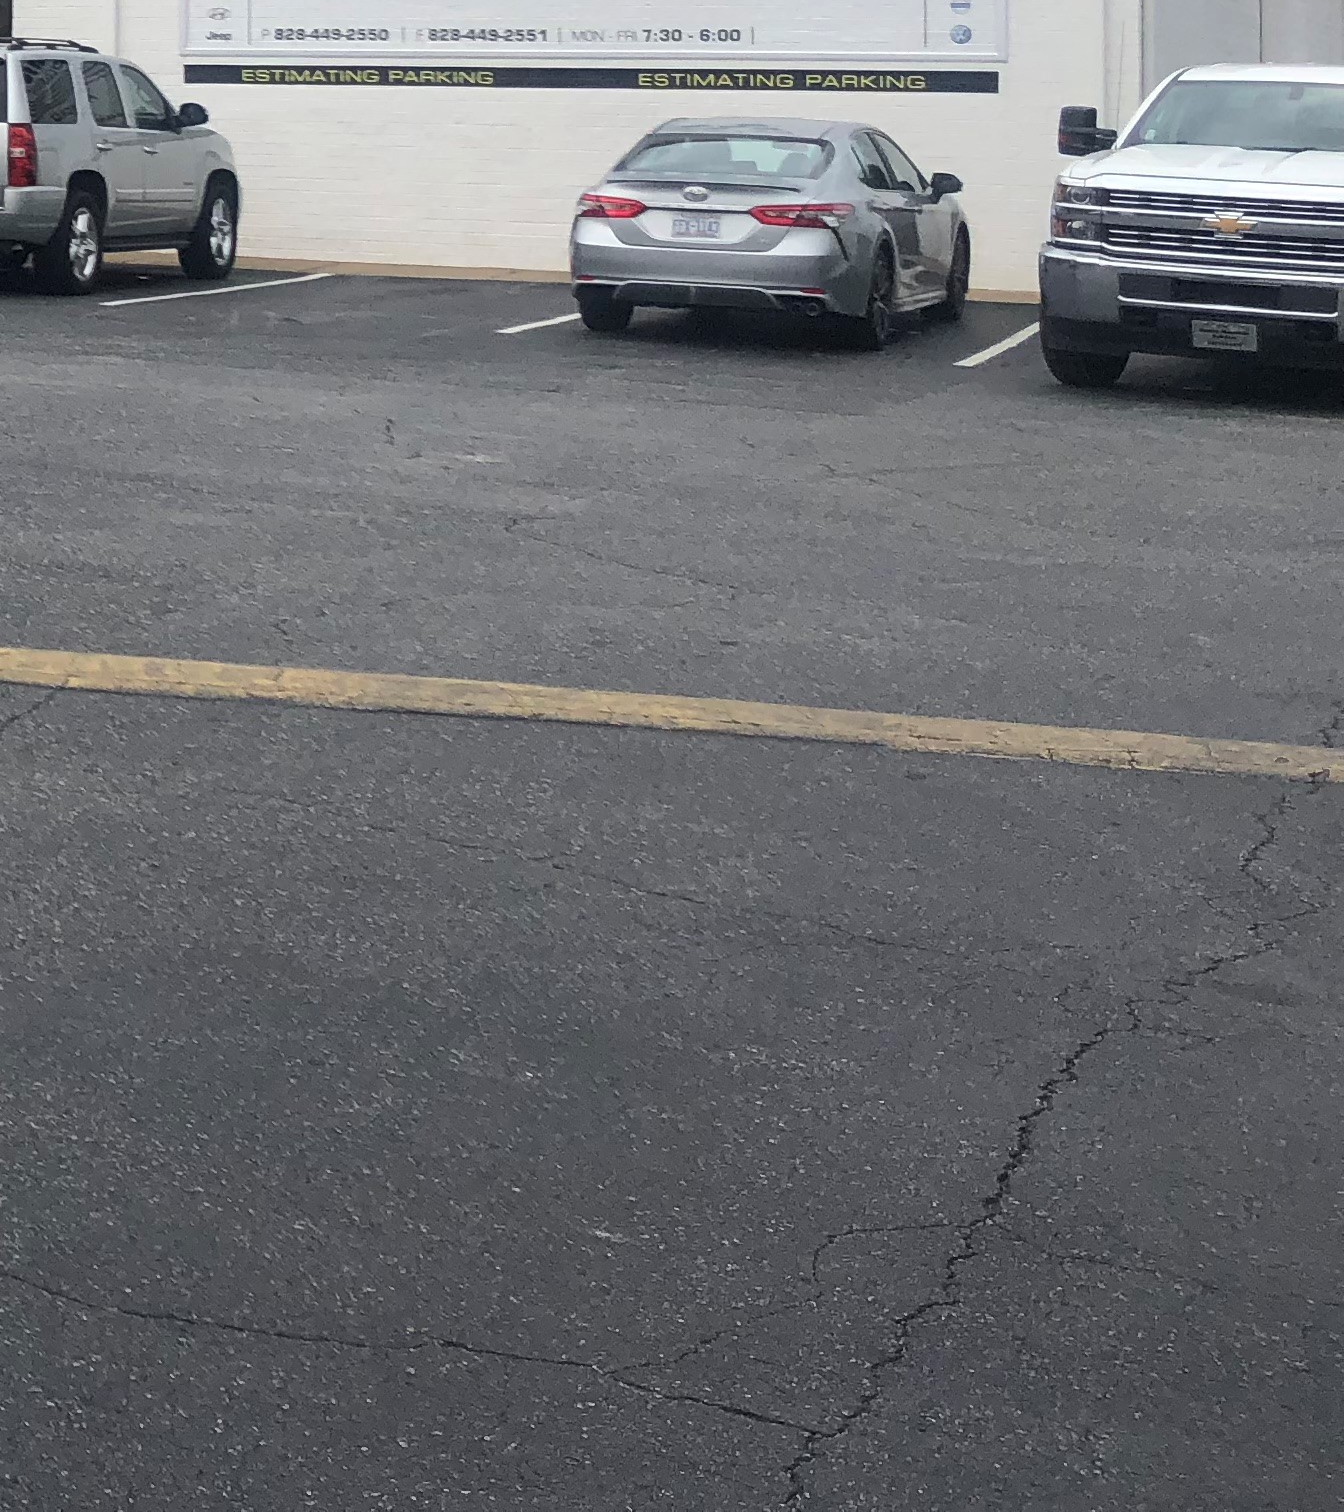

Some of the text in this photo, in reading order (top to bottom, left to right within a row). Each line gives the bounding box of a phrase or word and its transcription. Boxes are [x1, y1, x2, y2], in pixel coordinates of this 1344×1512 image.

[205, 31, 233, 40] Jeep
[274, 28, 389, 41] 828-449-2550
[428, 28, 548, 42] 828-449-2551
[571, 29, 605, 42] MON
[617, 29, 638, 42] FRI
[642, 28, 682, 42] 7:30
[700, 28, 741, 42] 6:00
[241, 68, 494, 85] ESTIMATING PARKING
[638, 73, 927, 90] ESTIMATING PARKING
